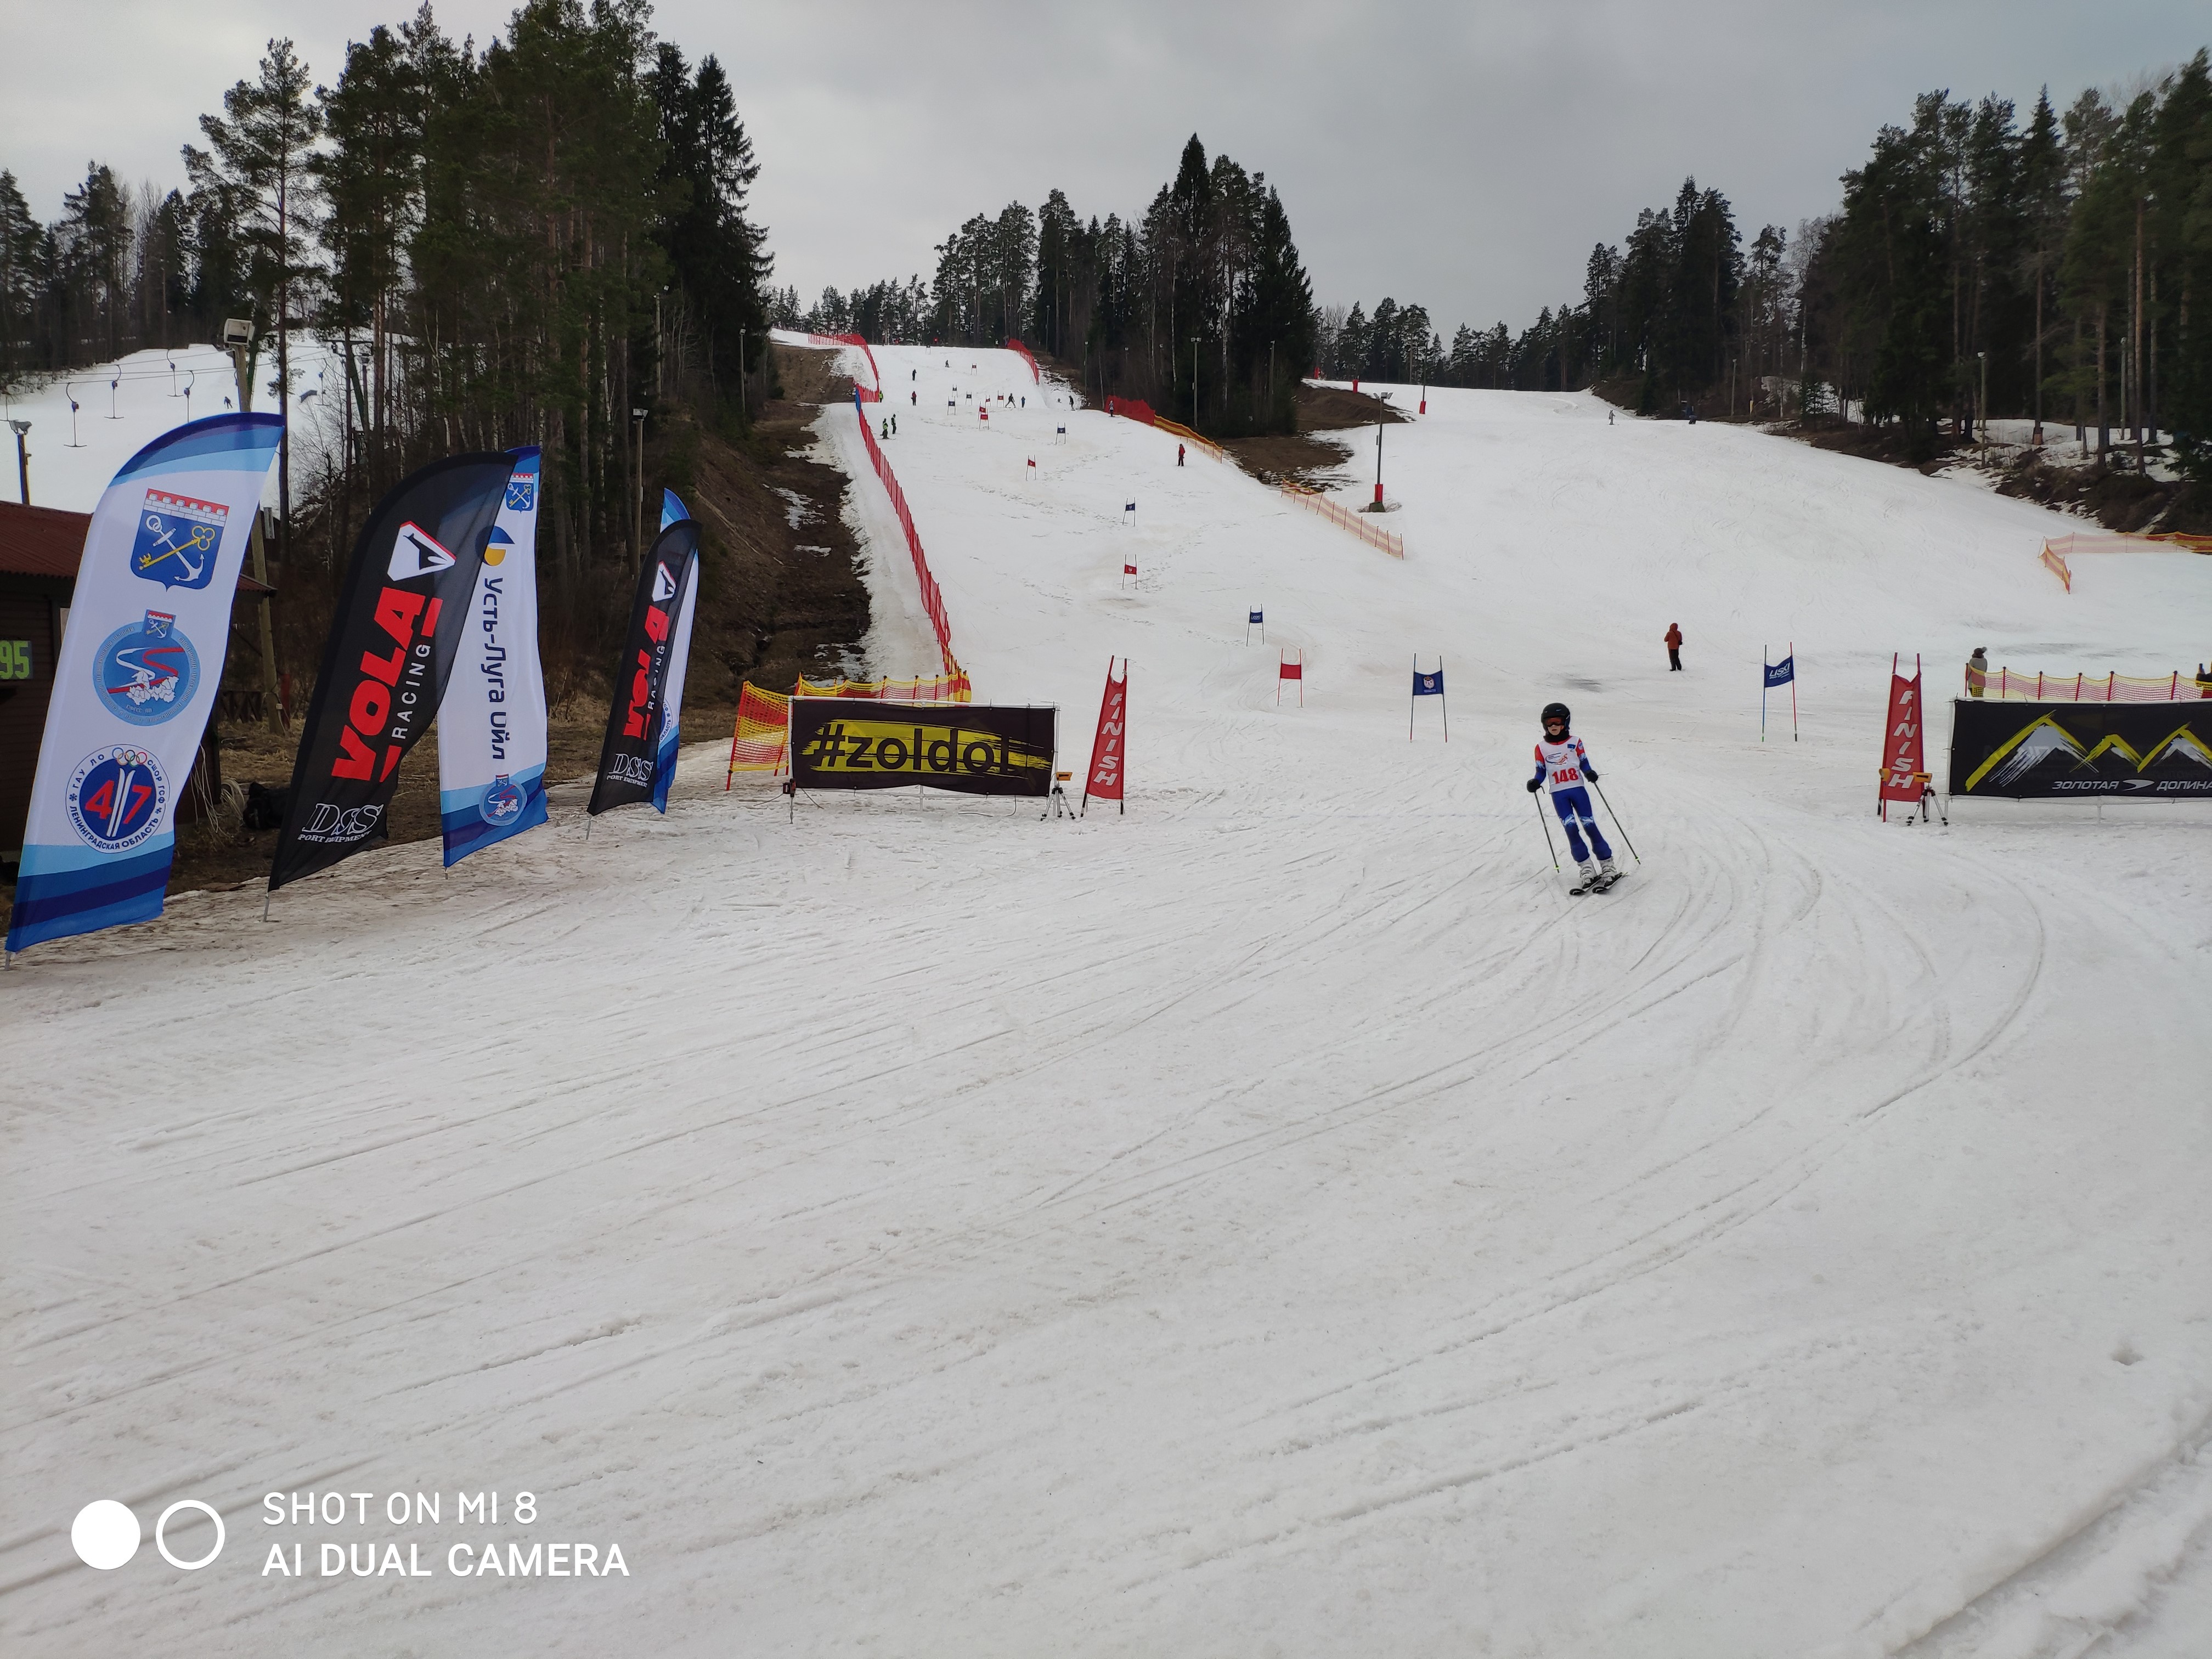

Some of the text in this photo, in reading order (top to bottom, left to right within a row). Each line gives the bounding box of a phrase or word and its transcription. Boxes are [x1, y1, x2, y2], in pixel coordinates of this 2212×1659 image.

[481, 577, 506, 703] Усть-Луга
[331, 586, 426, 781] VOLA
[392, 644, 431, 740] RACING
[647, 646, 665, 710] RACING
[1769, 662, 1790, 676] LISKI
[490, 712, 510, 760] Ойл
[1093, 693, 1123, 786] FINISH
[1888, 690, 1917, 788] FINISH
[73, 769, 85, 789] ГАУ
[90, 754, 105, 766] ЛО
[147, 759, 162, 781] СШОР
[608, 753, 654, 781] DSS
[1552, 768, 1578, 785] 148
[2052, 781, 2212, 791] ЗОЛОТАЯ ДОЛИНА
[70, 806, 159, 850] ЛЕНИНГРАДСКАЯ ОБЛАСТЬ
